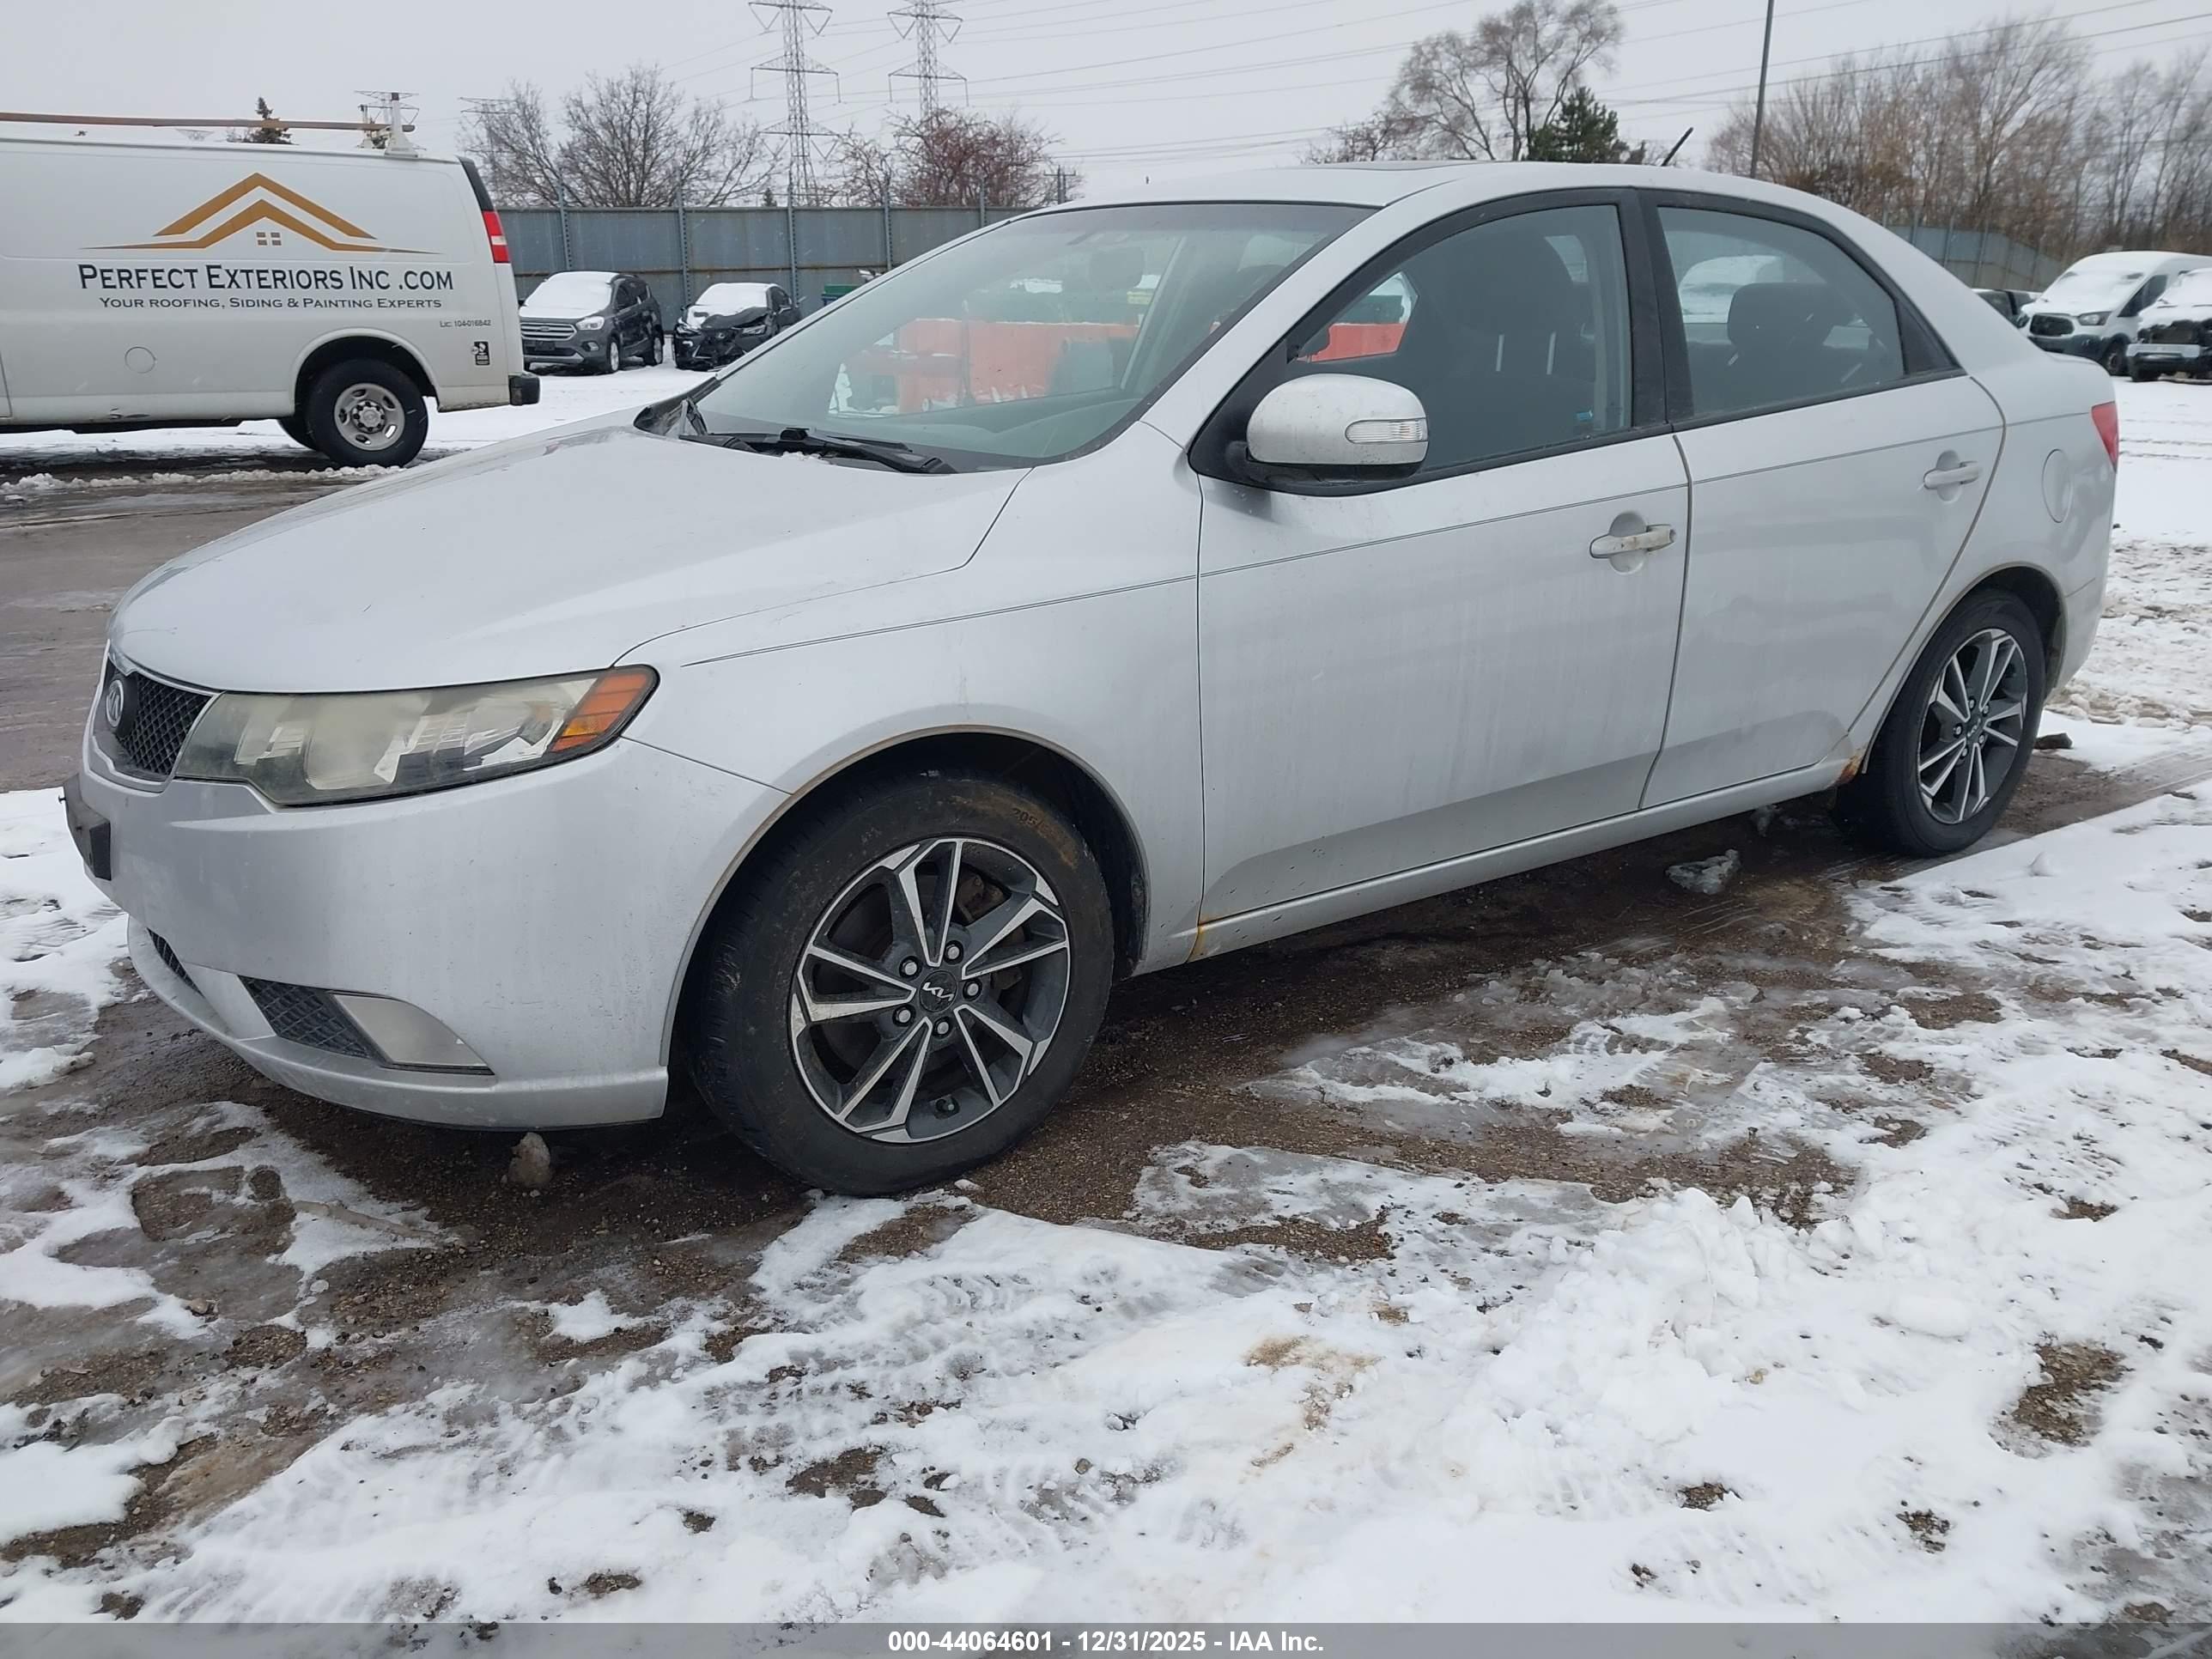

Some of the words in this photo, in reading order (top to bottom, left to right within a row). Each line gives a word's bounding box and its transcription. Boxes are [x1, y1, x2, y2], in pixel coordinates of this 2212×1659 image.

[78, 264, 198, 289] PERFECT
[205, 264, 343, 290] EXTERIORS
[349, 265, 391, 290] INC
[398, 270, 454, 290] .COM
[99, 297, 144, 308] YOUR
[149, 299, 225, 310] ROOFING,
[229, 297, 283, 309] SIDING
[287, 298, 300, 308] &
[302, 298, 373, 309] PAINTING
[377, 298, 442, 309] EXPERTS
